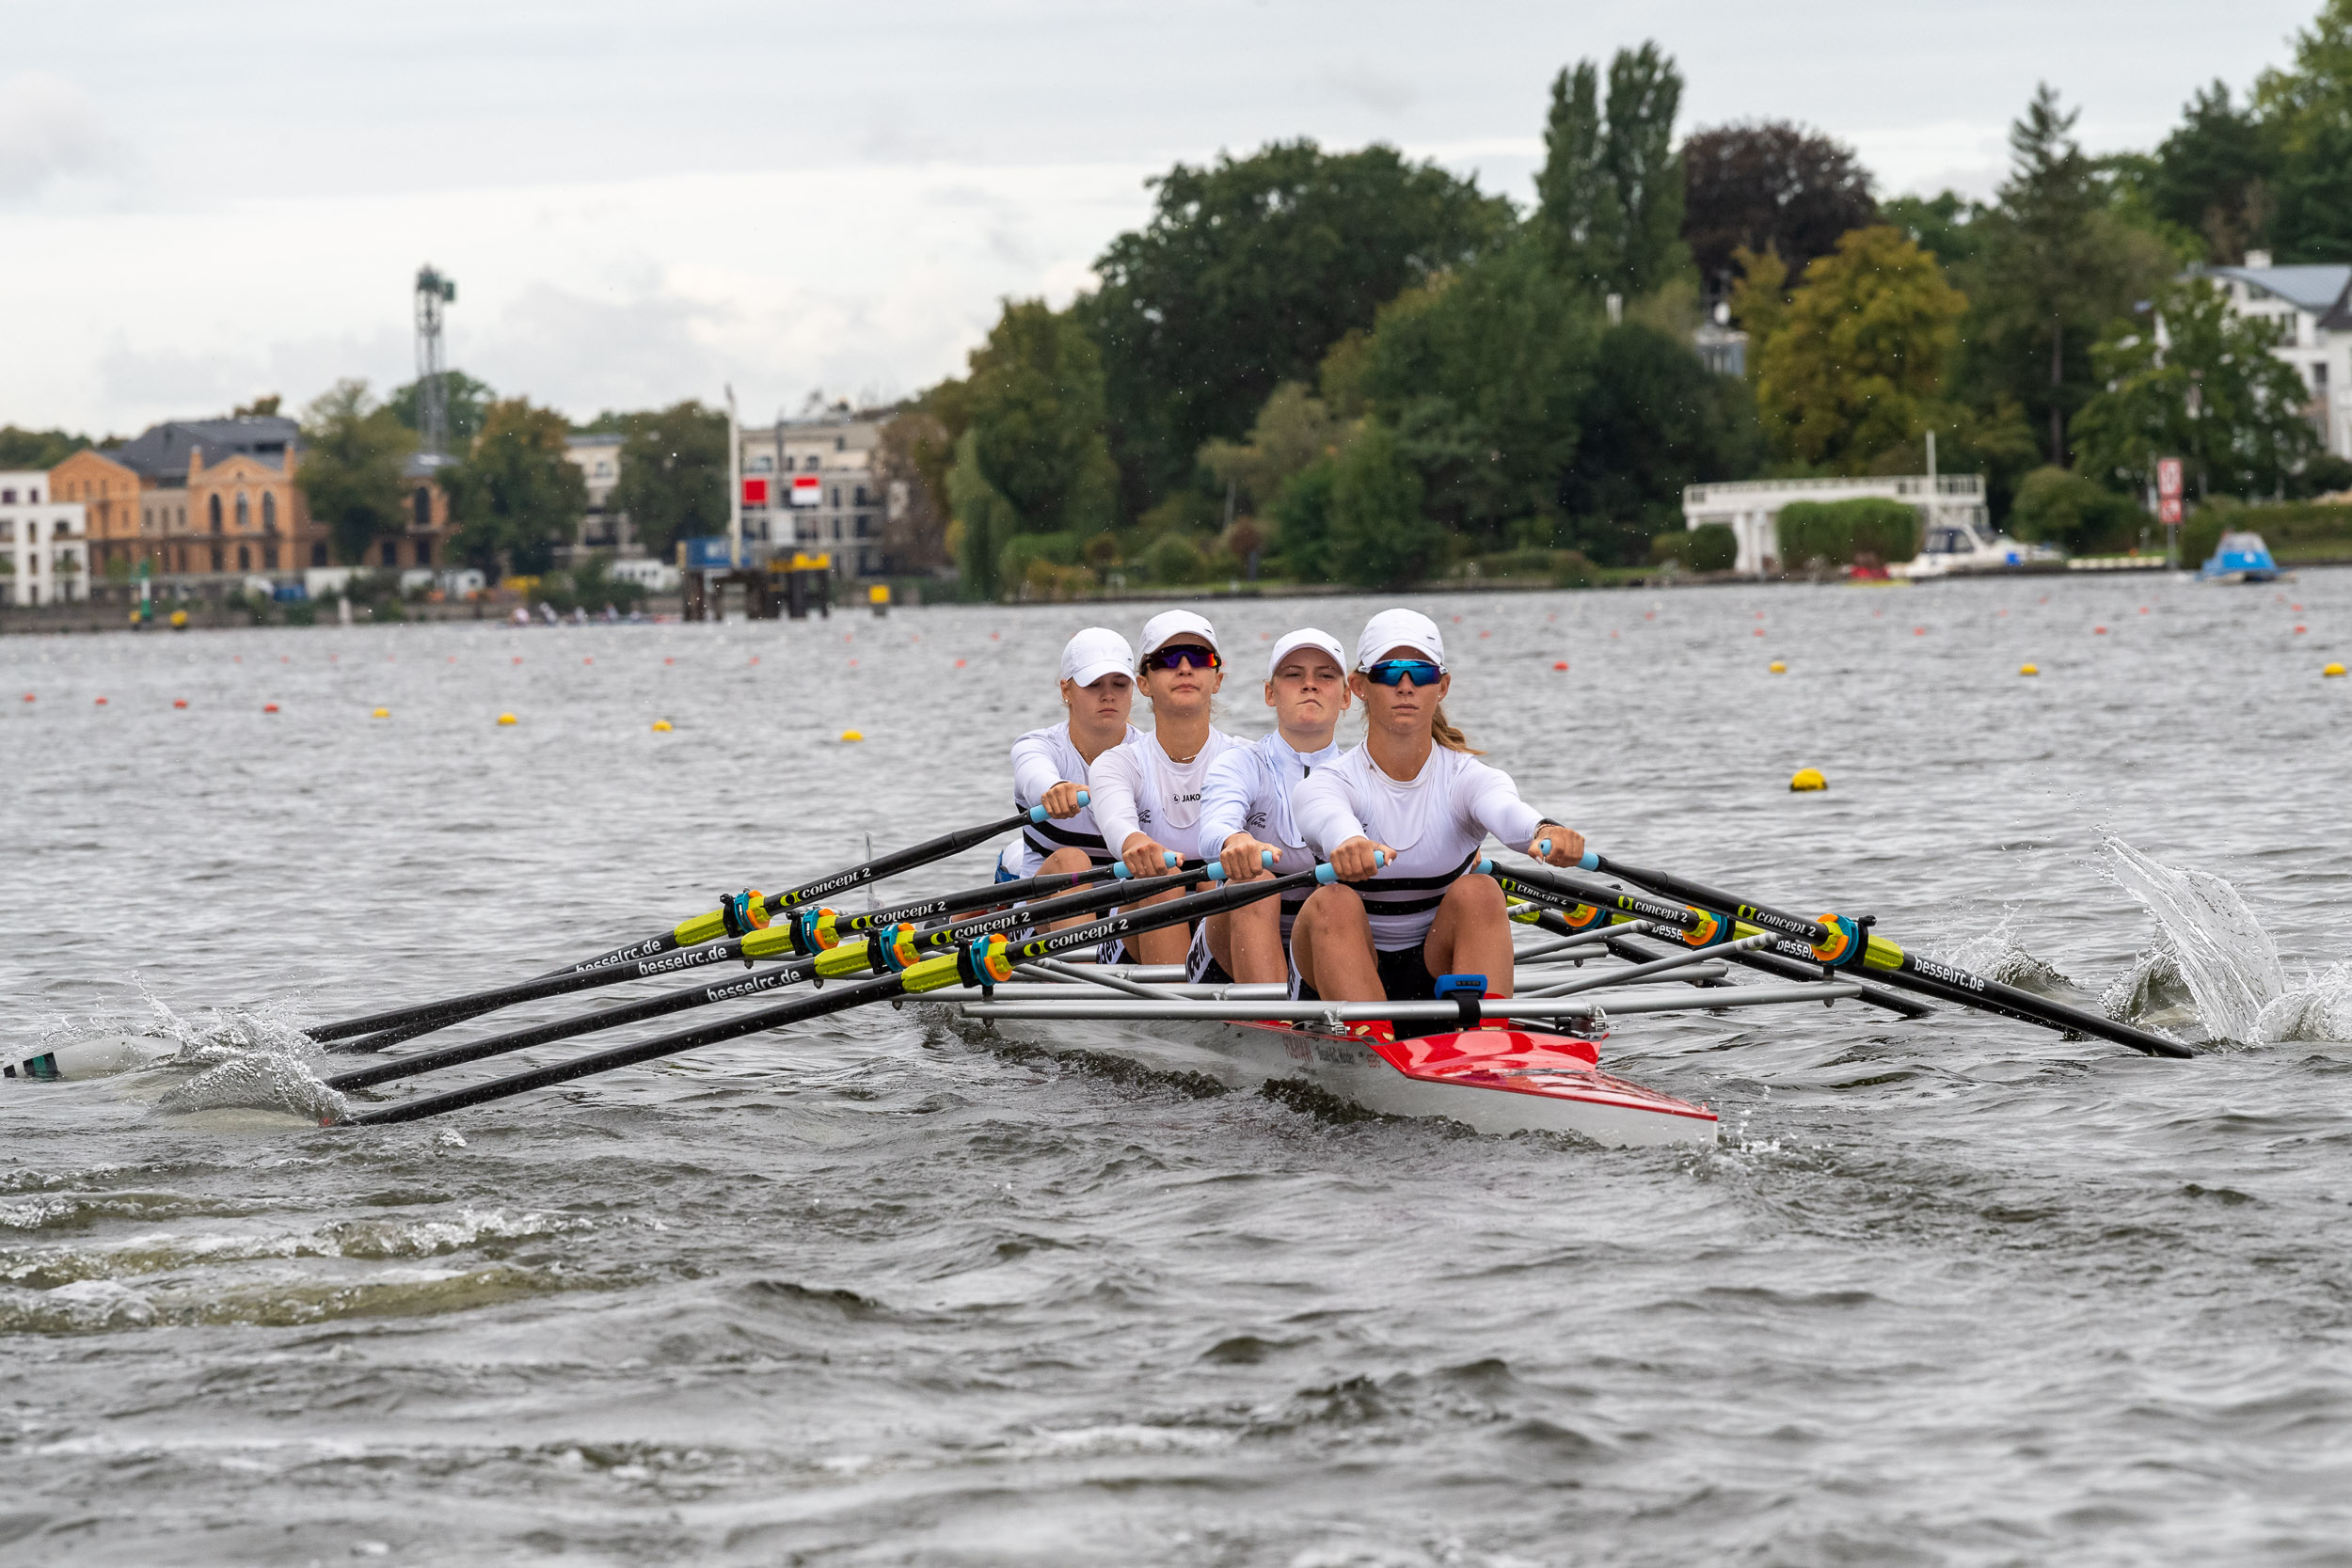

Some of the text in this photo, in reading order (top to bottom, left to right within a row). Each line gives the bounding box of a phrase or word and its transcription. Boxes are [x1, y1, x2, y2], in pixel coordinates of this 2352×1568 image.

[1182, 794, 1201, 802] JAKO
[802, 867, 871, 898] concept 2
[874, 901, 946, 925] concept 2
[955, 915, 1018, 936] concept
[1022, 911, 1030, 923] 2
[1634, 899, 1688, 923] concept 2
[1756, 911, 1817, 937] concept 2
[1049, 923, 1115, 949] concept
[1119, 918, 1129, 929] 2
[638, 945, 727, 975] besselrc.de
[1914, 955, 1984, 991] besselrc.de
[707, 969, 802, 1002] besselrc.de
